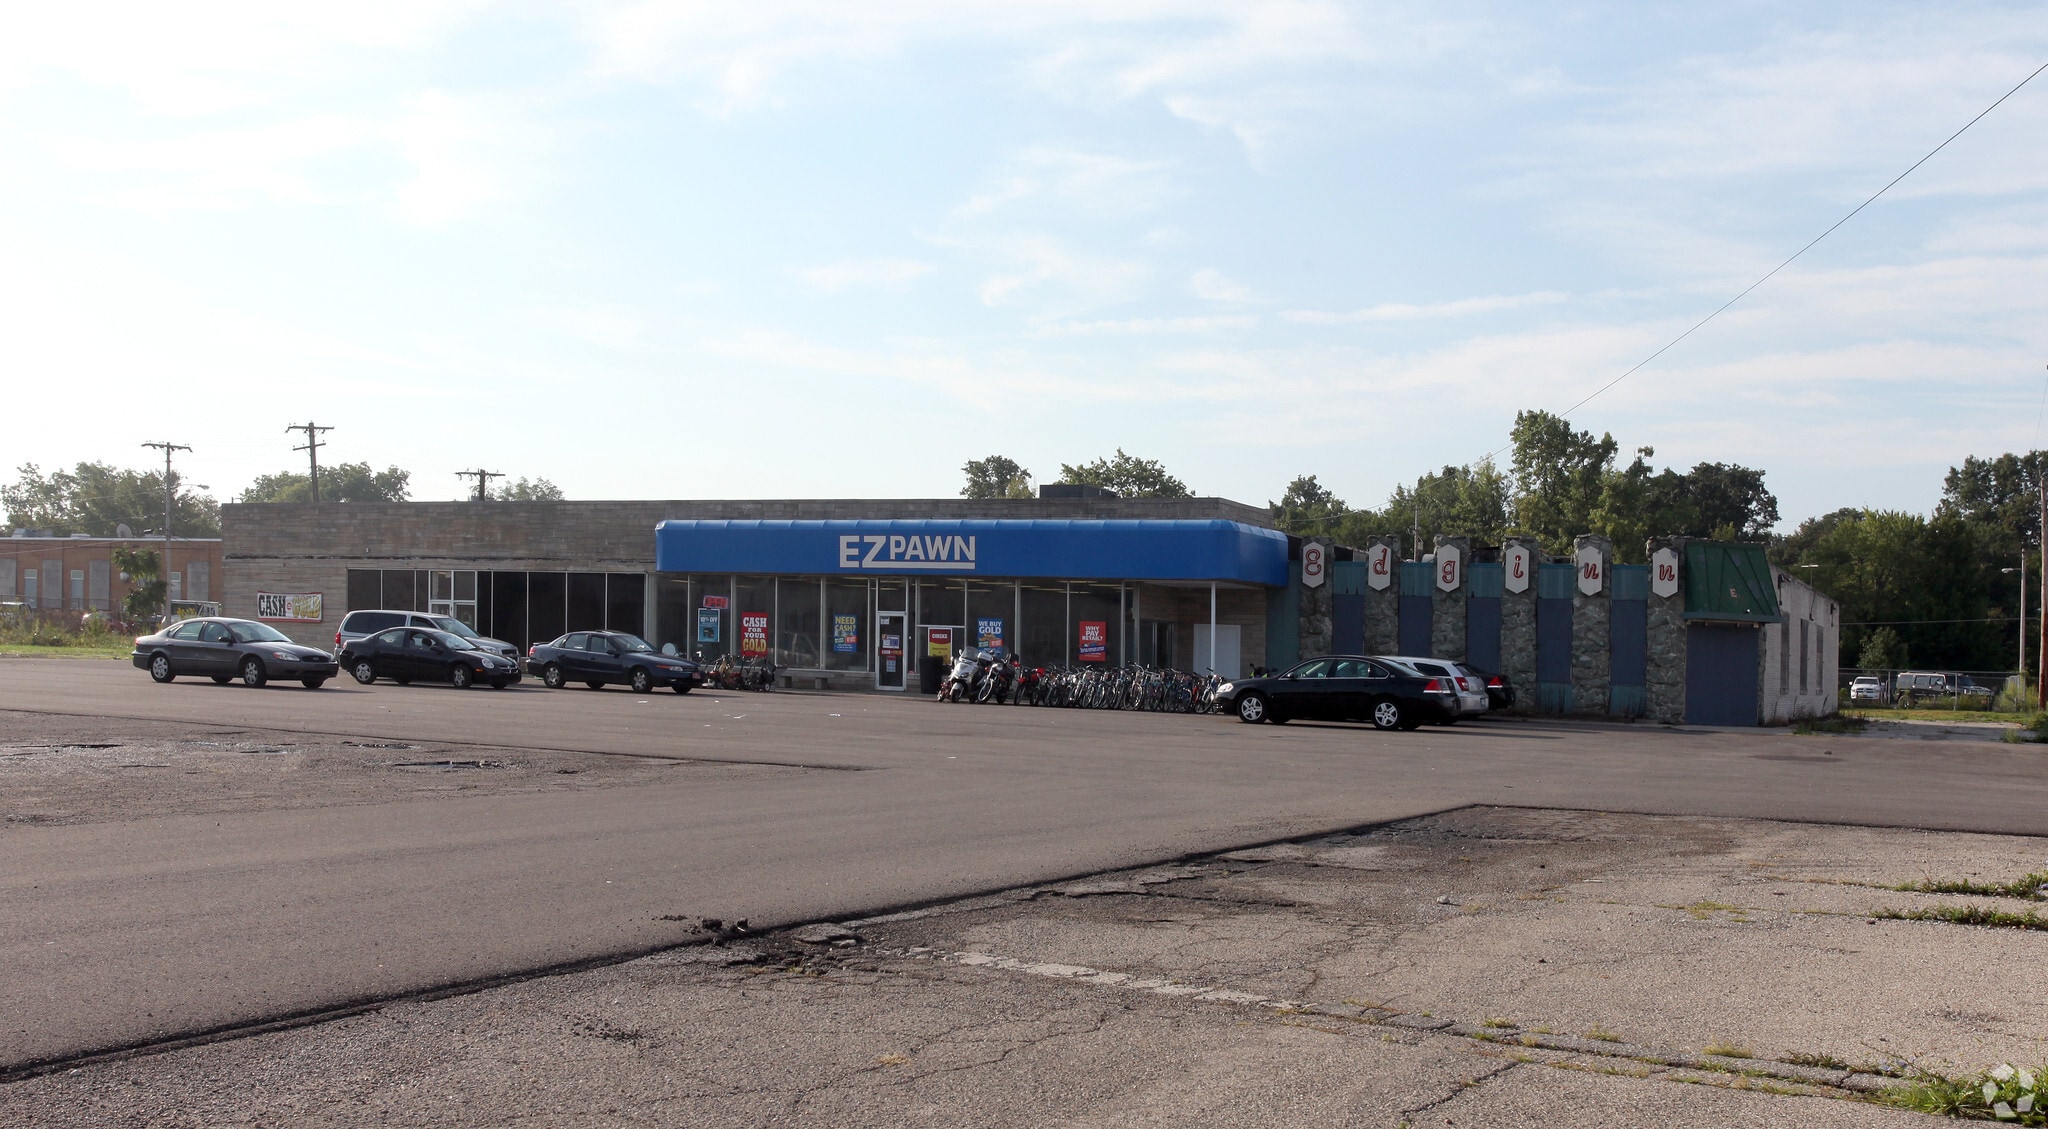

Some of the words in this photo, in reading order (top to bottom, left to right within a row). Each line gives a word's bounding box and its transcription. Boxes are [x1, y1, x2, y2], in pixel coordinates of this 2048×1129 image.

[258, 594, 286, 617] CASH
[292, 595, 321, 618] GOLD
[743, 616, 767, 627] CASH
[834, 616, 856, 624] NEED
[834, 624, 856, 632] CASH?
[978, 626, 1002, 634] GOLD
[743, 638, 767, 652] GOLD
